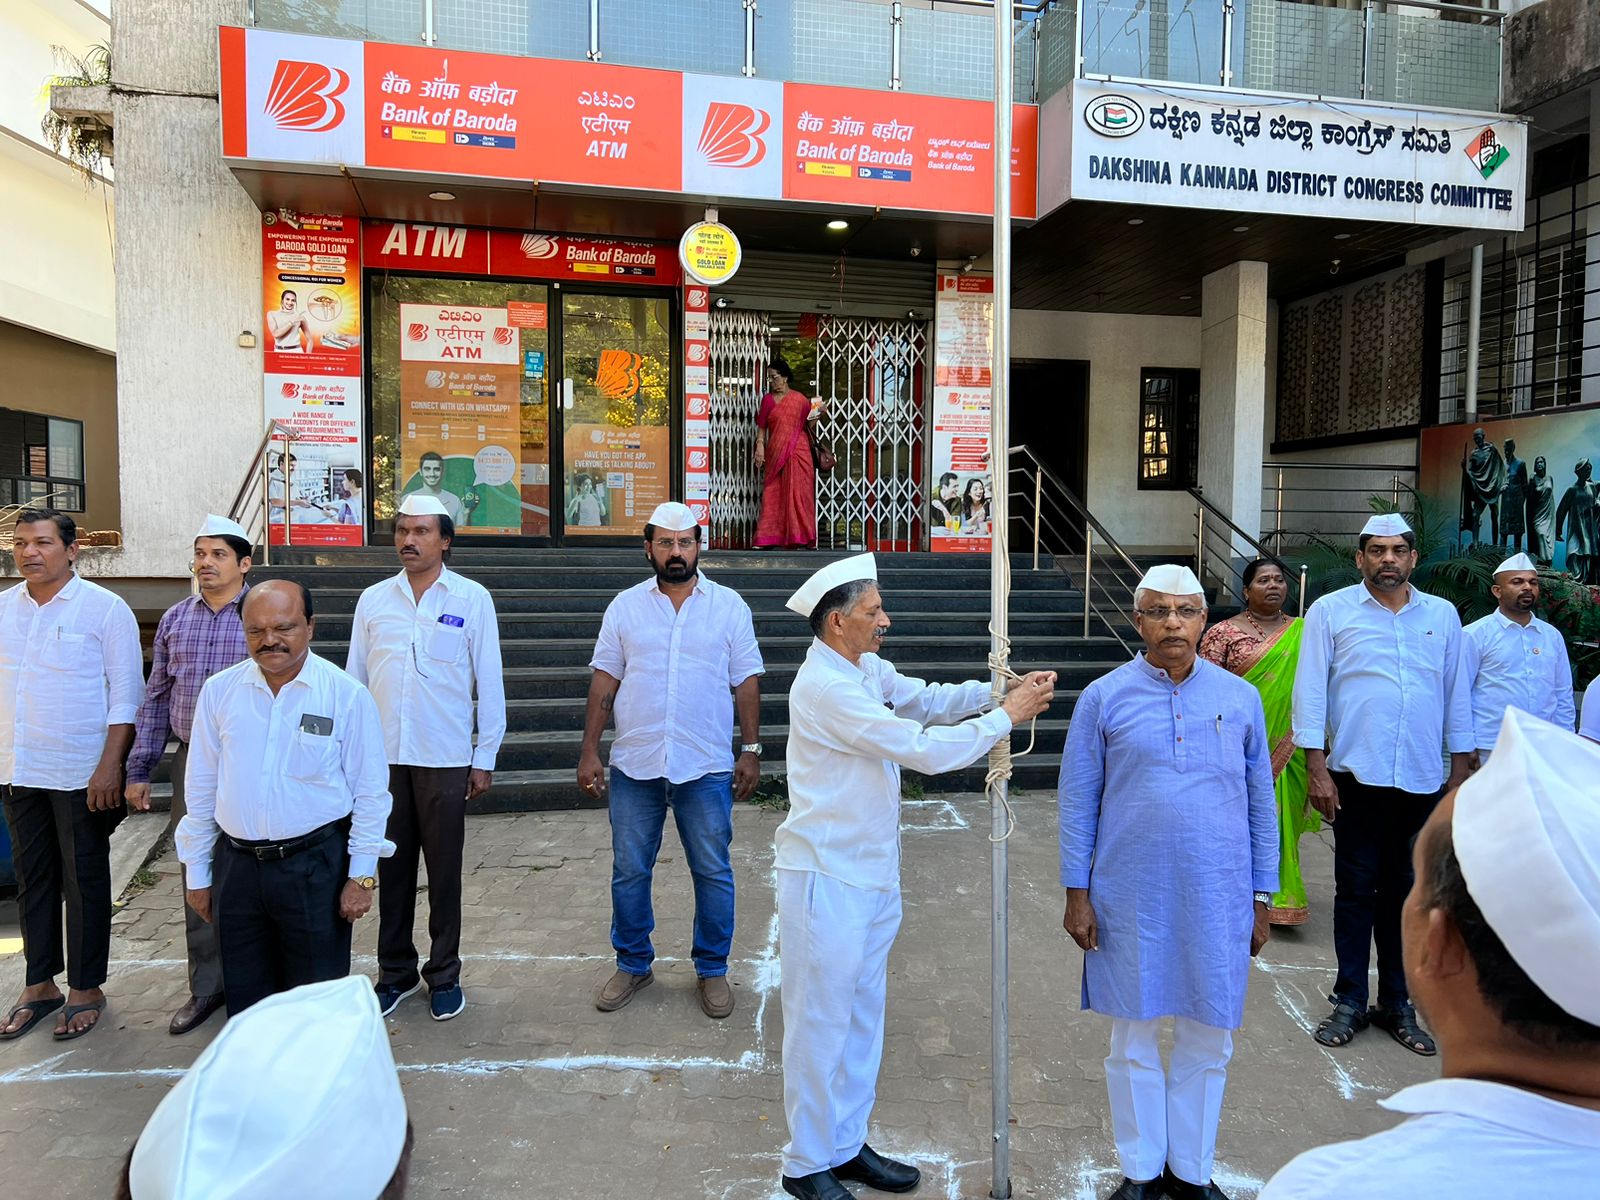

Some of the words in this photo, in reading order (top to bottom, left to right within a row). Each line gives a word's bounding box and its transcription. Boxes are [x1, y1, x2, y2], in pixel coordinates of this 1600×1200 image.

[381, 71, 411, 94] बैंक
[469, 82, 518, 106] बड़ौदा
[578, 91, 635, 109] ಎಟಿಎಂ
[381, 102, 429, 124] Bank
[432, 108, 451, 126] of
[453, 109, 516, 132] Baroda
[582, 112, 631, 136] एटीएम
[797, 111, 824, 132] बैंक
[872, 119, 914, 142] बड़ौदा
[1150, 102, 1200, 140] ದಕ್ಷಿಣ
[1211, 108, 1261, 147] ಕನ್ನಡ
[1270, 114, 1313, 151] ಜಿಲ್ಲಾ
[1322, 120, 1395, 155] ಕಾಂಗ್ರೆಸ್
[1402, 126, 1451, 154] ಸಮಿತಿ
[586, 140, 627, 159] ATM
[796, 140, 837, 160] Bank
[840, 144, 857, 160] of
[858, 145, 913, 166] Baroda
[928, 161, 944, 169] Bank
[945, 162, 952, 170] of
[952, 163, 975, 172] Baroda
[1090, 155, 1171, 185] DAKSHINA
[1180, 163, 1258, 192] KANNADA
[1267, 170, 1337, 197] DISTRICT
[1344, 177, 1424, 204] CONGRESS
[1431, 183, 1512, 211] COMMITTEE
[323, 219, 343, 227] Baroda
[276, 241, 305, 251] BARODA
[307, 243, 326, 252] GOLD
[328, 244, 347, 254] LOAN
[380, 223, 467, 258] ATM
[566, 245, 598, 261] Bank
[600, 248, 612, 262] of
[613, 248, 656, 264] Baroda
[439, 310, 482, 322] ಎಟಿಎಂ
[435, 325, 485, 344] एटीएम
[441, 346, 482, 359] ATM
